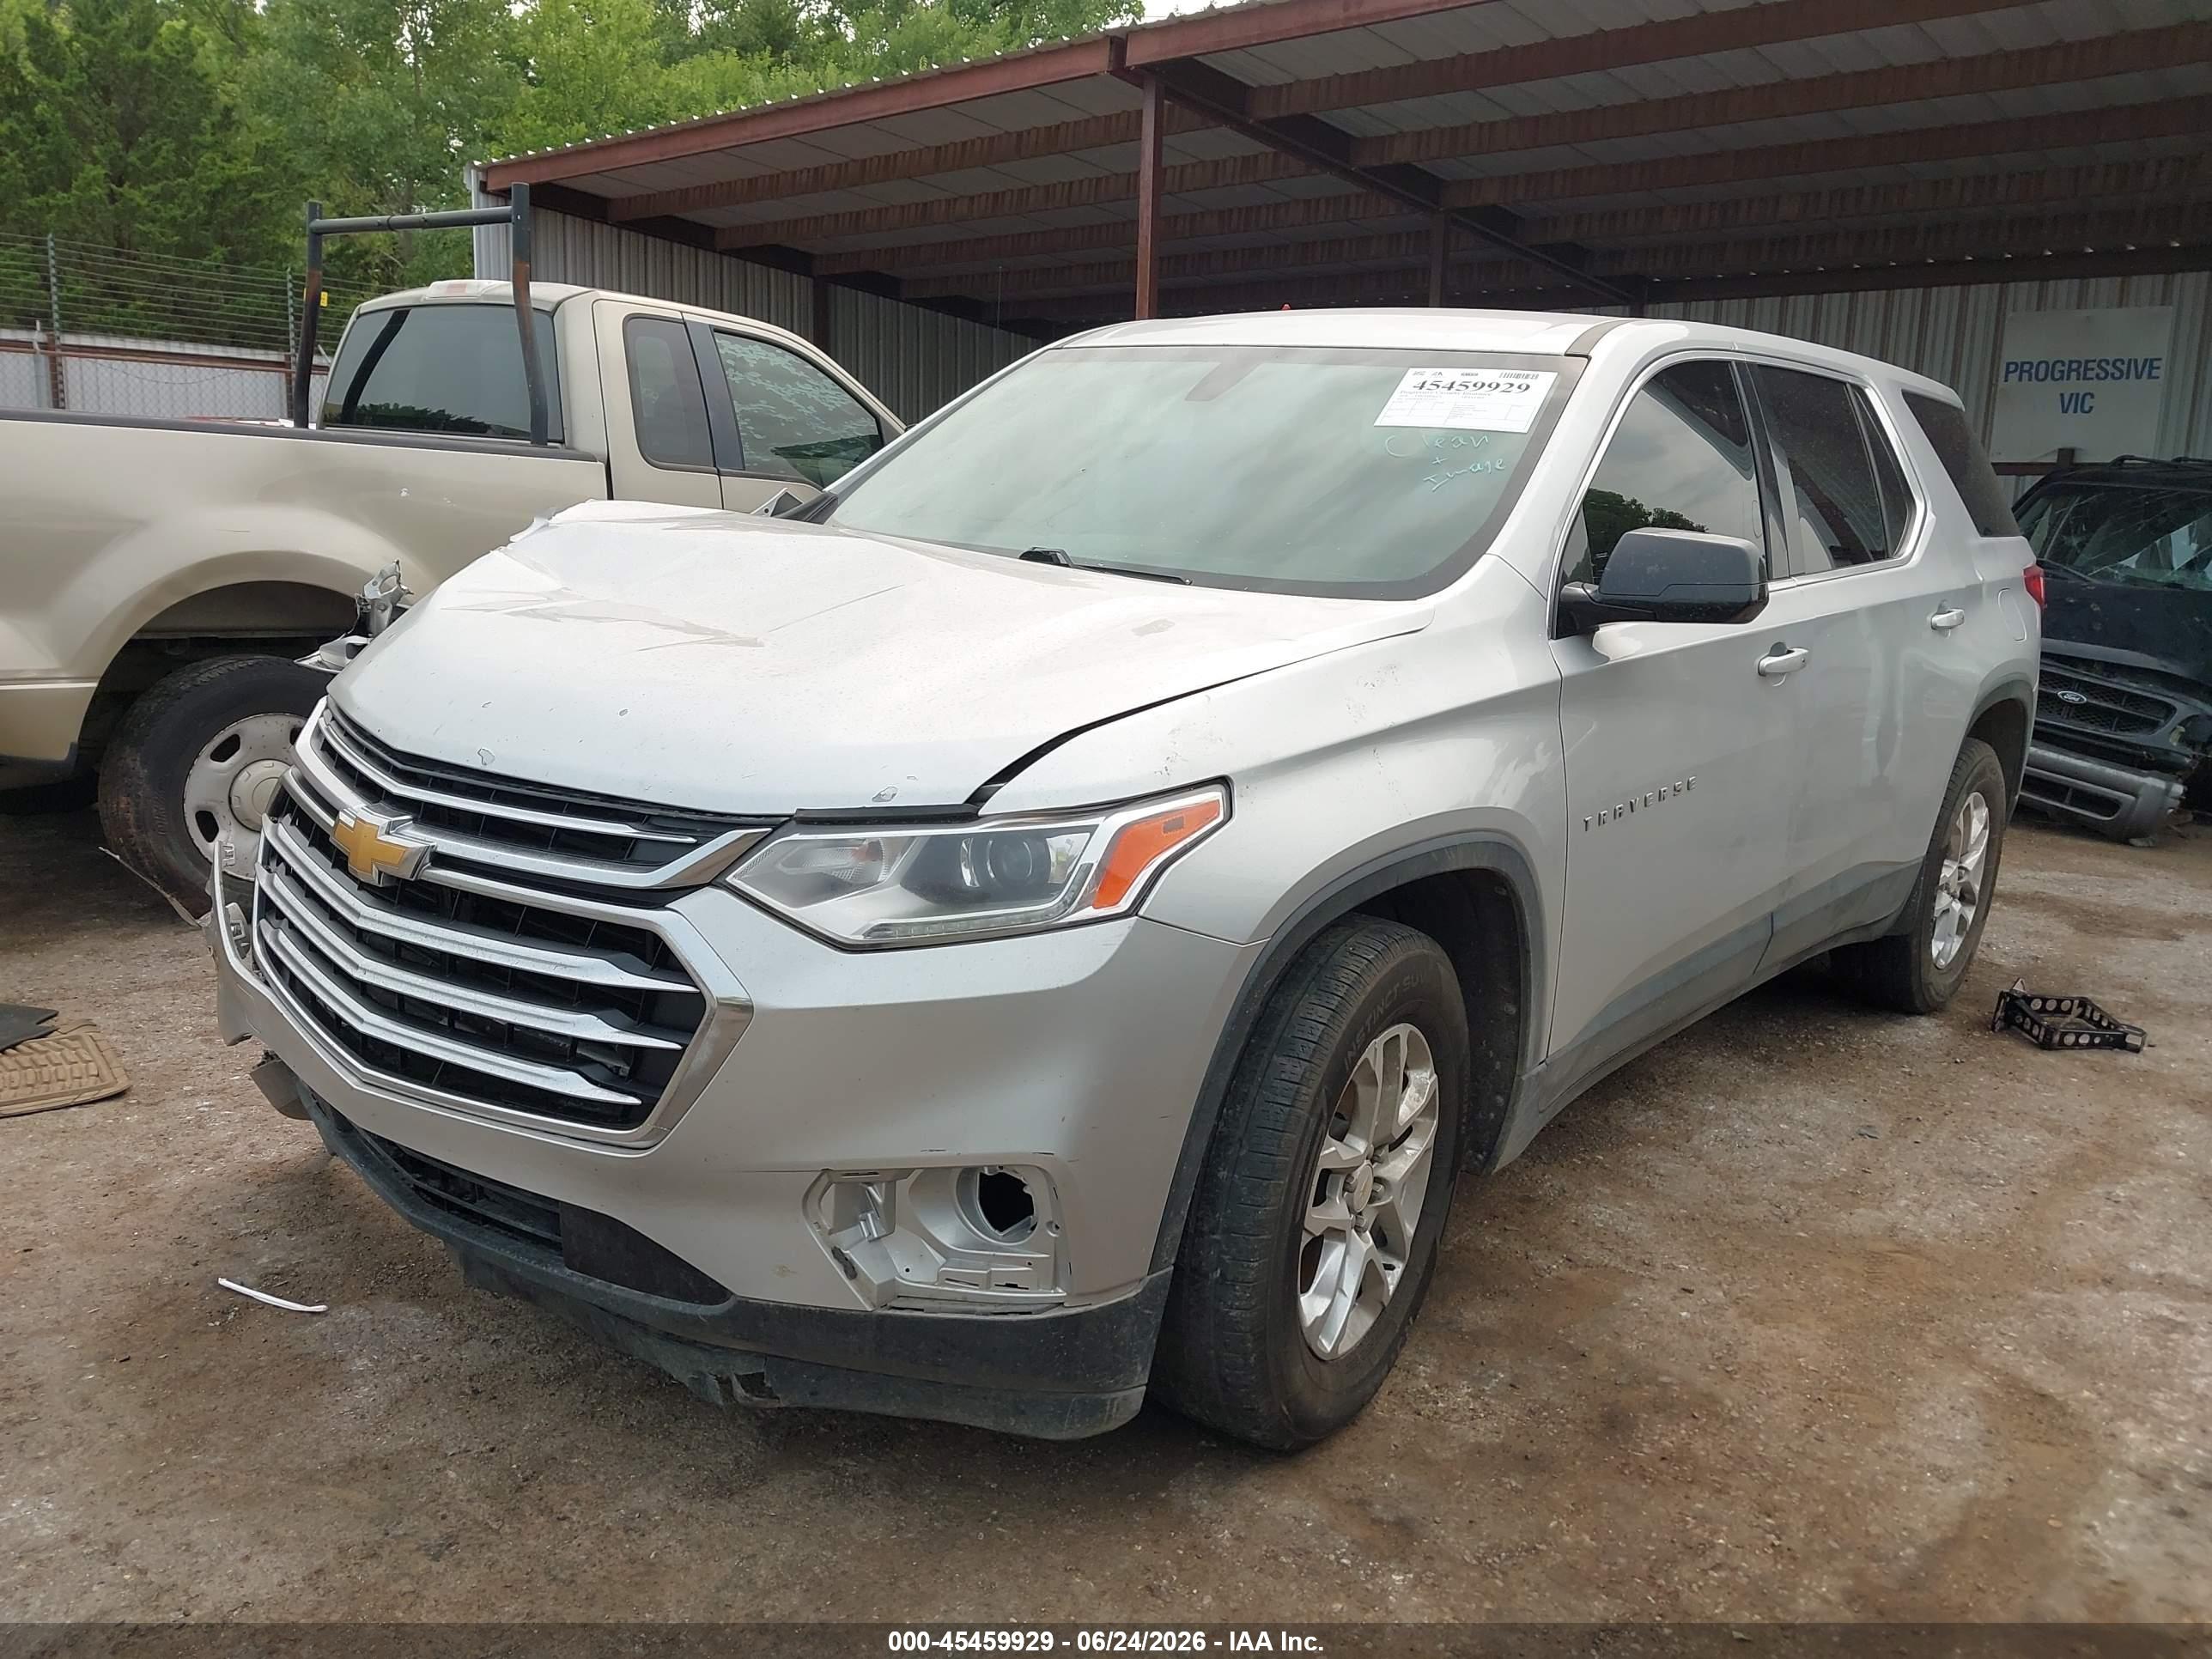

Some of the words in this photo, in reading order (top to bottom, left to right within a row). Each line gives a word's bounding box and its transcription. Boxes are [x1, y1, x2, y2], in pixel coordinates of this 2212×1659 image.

[2003, 358, 2162, 382] PROGRESSIVE
[1413, 380, 1530, 393] 45459929
[2060, 392, 2094, 414] VIC
[1583, 776, 1697, 832] TRAVERSE
